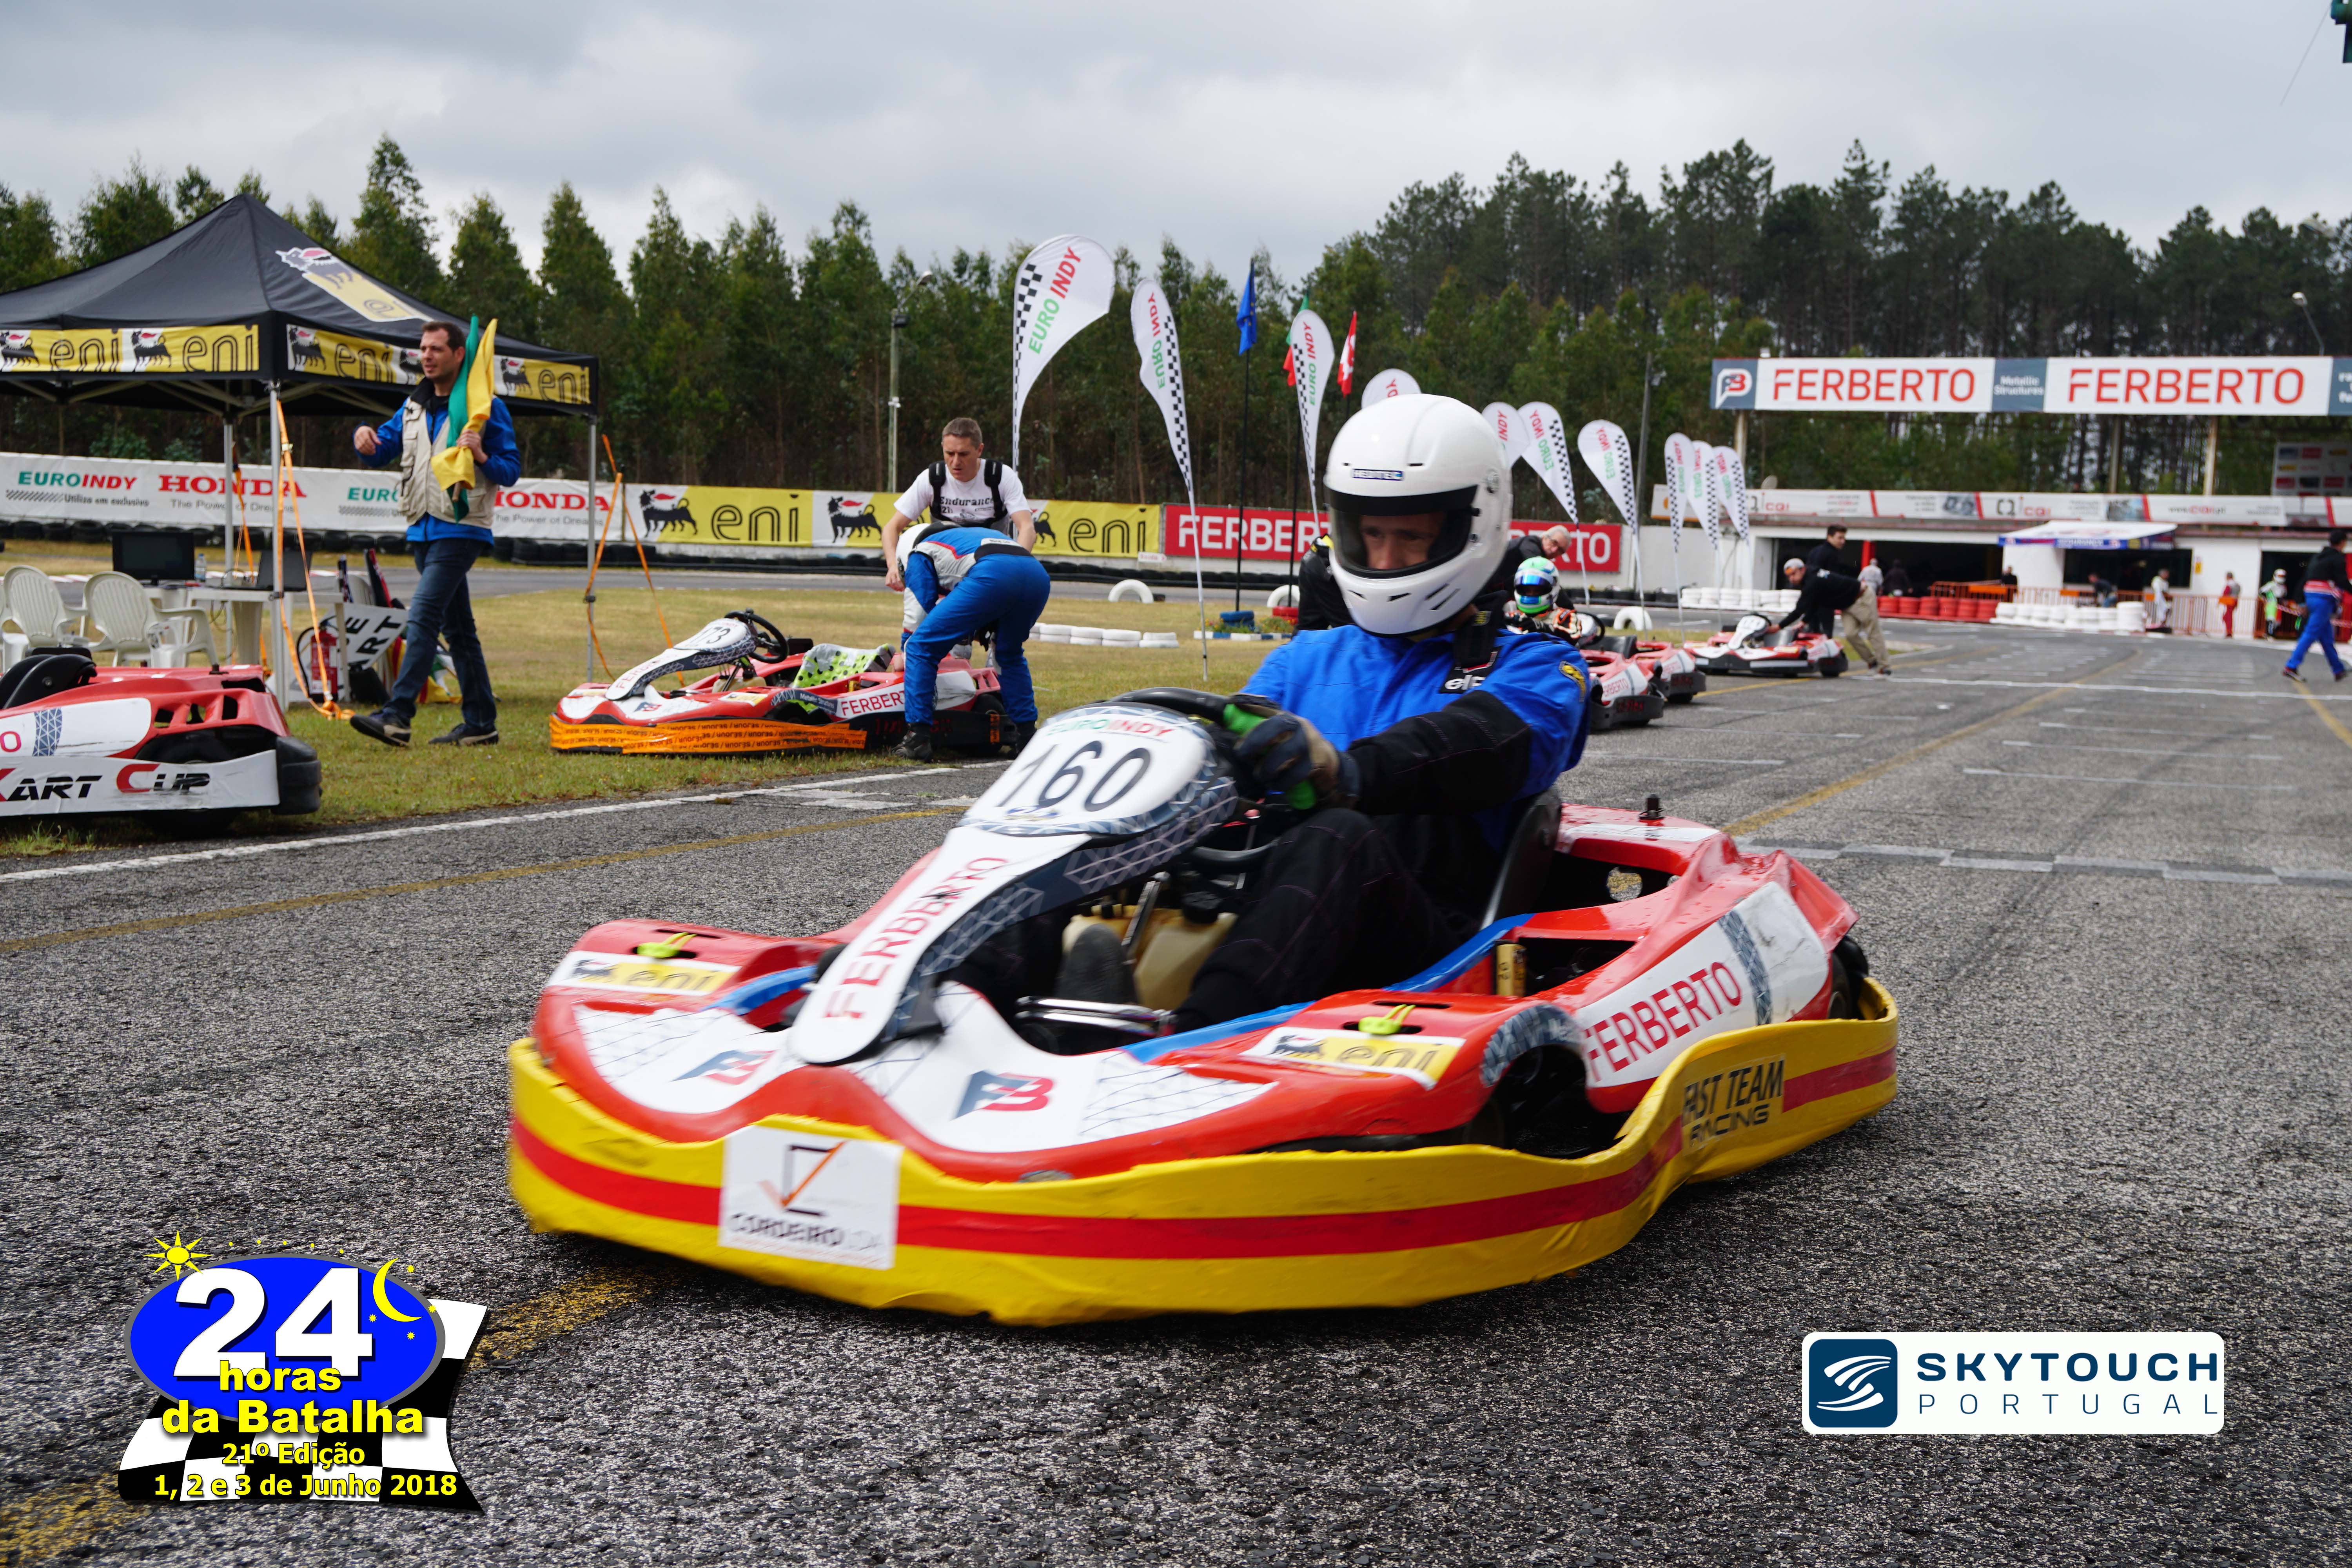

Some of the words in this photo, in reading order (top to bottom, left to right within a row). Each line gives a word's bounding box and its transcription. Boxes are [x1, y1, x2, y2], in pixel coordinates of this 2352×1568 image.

[1029, 299, 1060, 354] EURO
[1050, 247, 1082, 299] INDY
[49, 328, 120, 372] eni
[183, 325, 254, 372] eni
[1303, 321, 1316, 359] INDY
[335, 343, 392, 383] eni
[538, 366, 590, 404] eni
[1773, 368, 1975, 402] FERBERTO
[2068, 368, 2304, 405] FERBERTO
[18, 472, 137, 490] EUROINDY
[171, 499, 192, 508] The
[196, 499, 226, 509] Powe
[513, 514, 546, 524] Power
[711, 494, 799, 543] eni
[1068, 508, 1147, 554] eni
[1178, 514, 1332, 553] FERBER
[116, 763, 210, 794] CUP
[997, 740, 1151, 812] 160
[823, 857, 1009, 1019] FERBERTO
[1581, 962, 1742, 1082] FERBERTO
[1338, 1043, 1444, 1072] eni
[1727, 1059, 1785, 1110] TEAM
[1690, 1103, 1770, 1149] RACING
